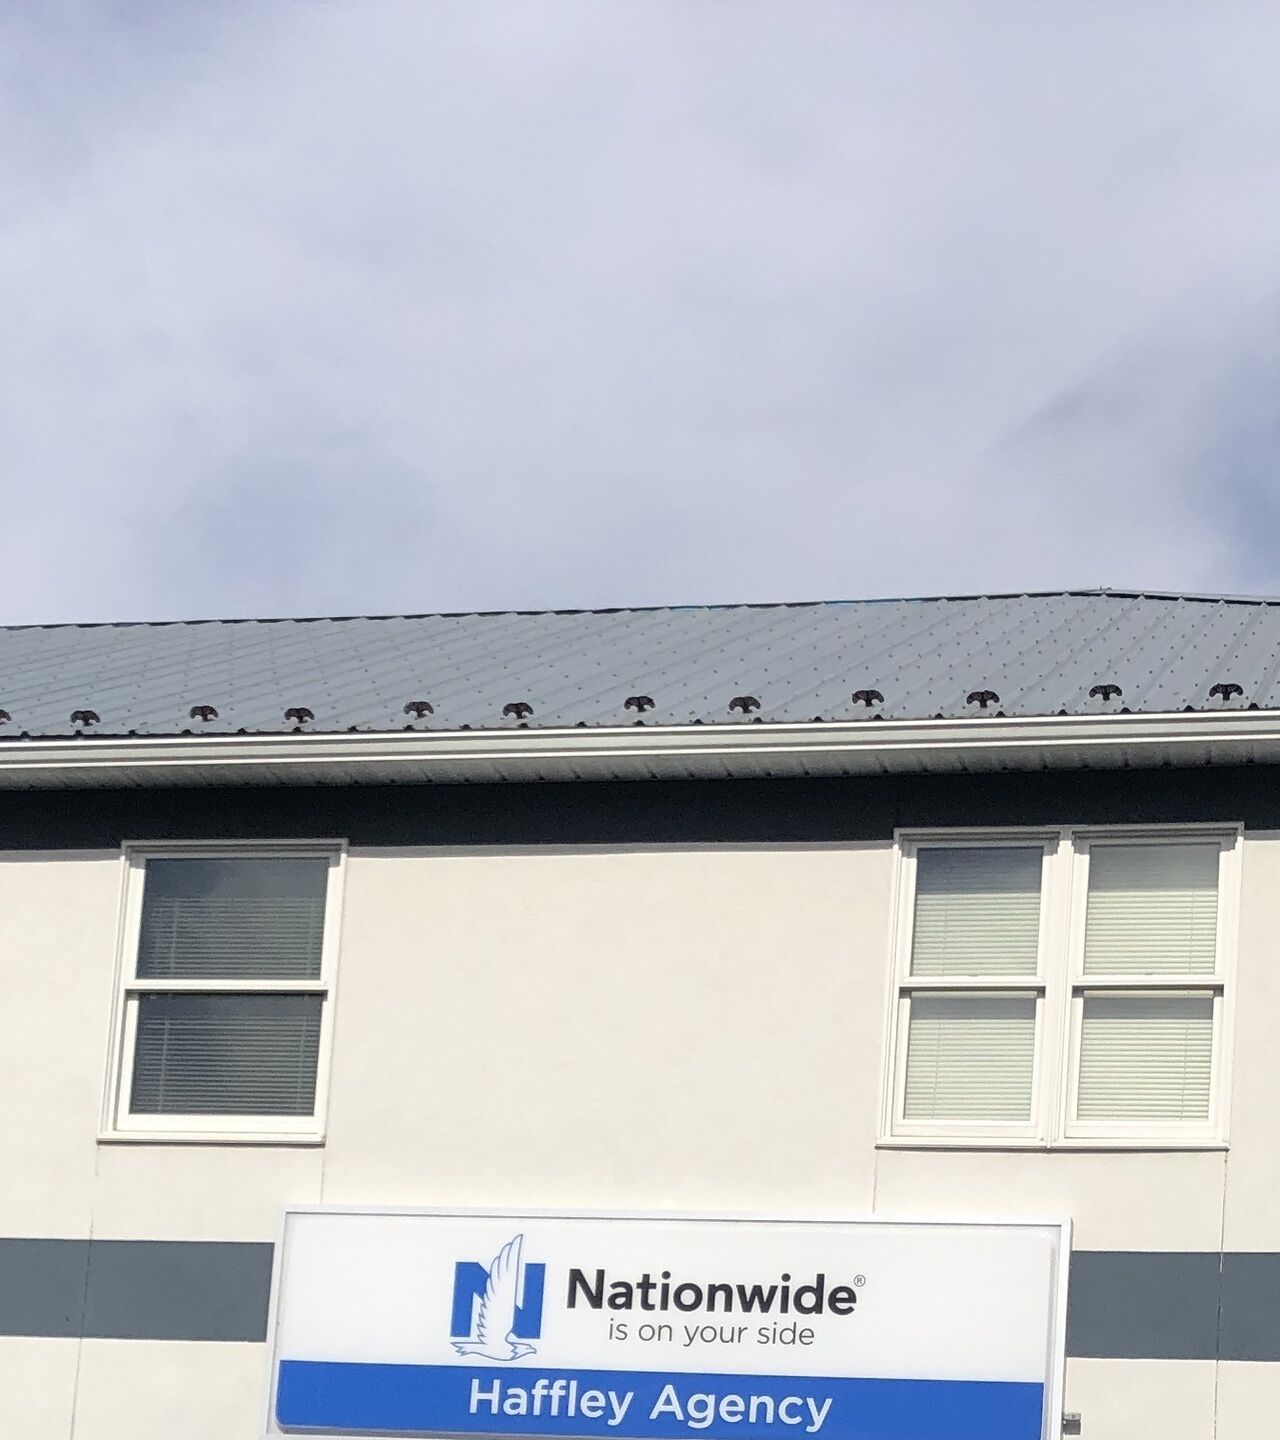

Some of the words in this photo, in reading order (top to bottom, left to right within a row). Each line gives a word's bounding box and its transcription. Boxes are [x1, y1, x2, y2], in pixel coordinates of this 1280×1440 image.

[608, 1317, 628, 1341] is
[638, 1321, 673, 1343] on
[683, 1322, 749, 1348] your
[756, 1321, 815, 1346] side
[468, 1377, 635, 1427] Haffley
[648, 1384, 834, 1434] Agency
